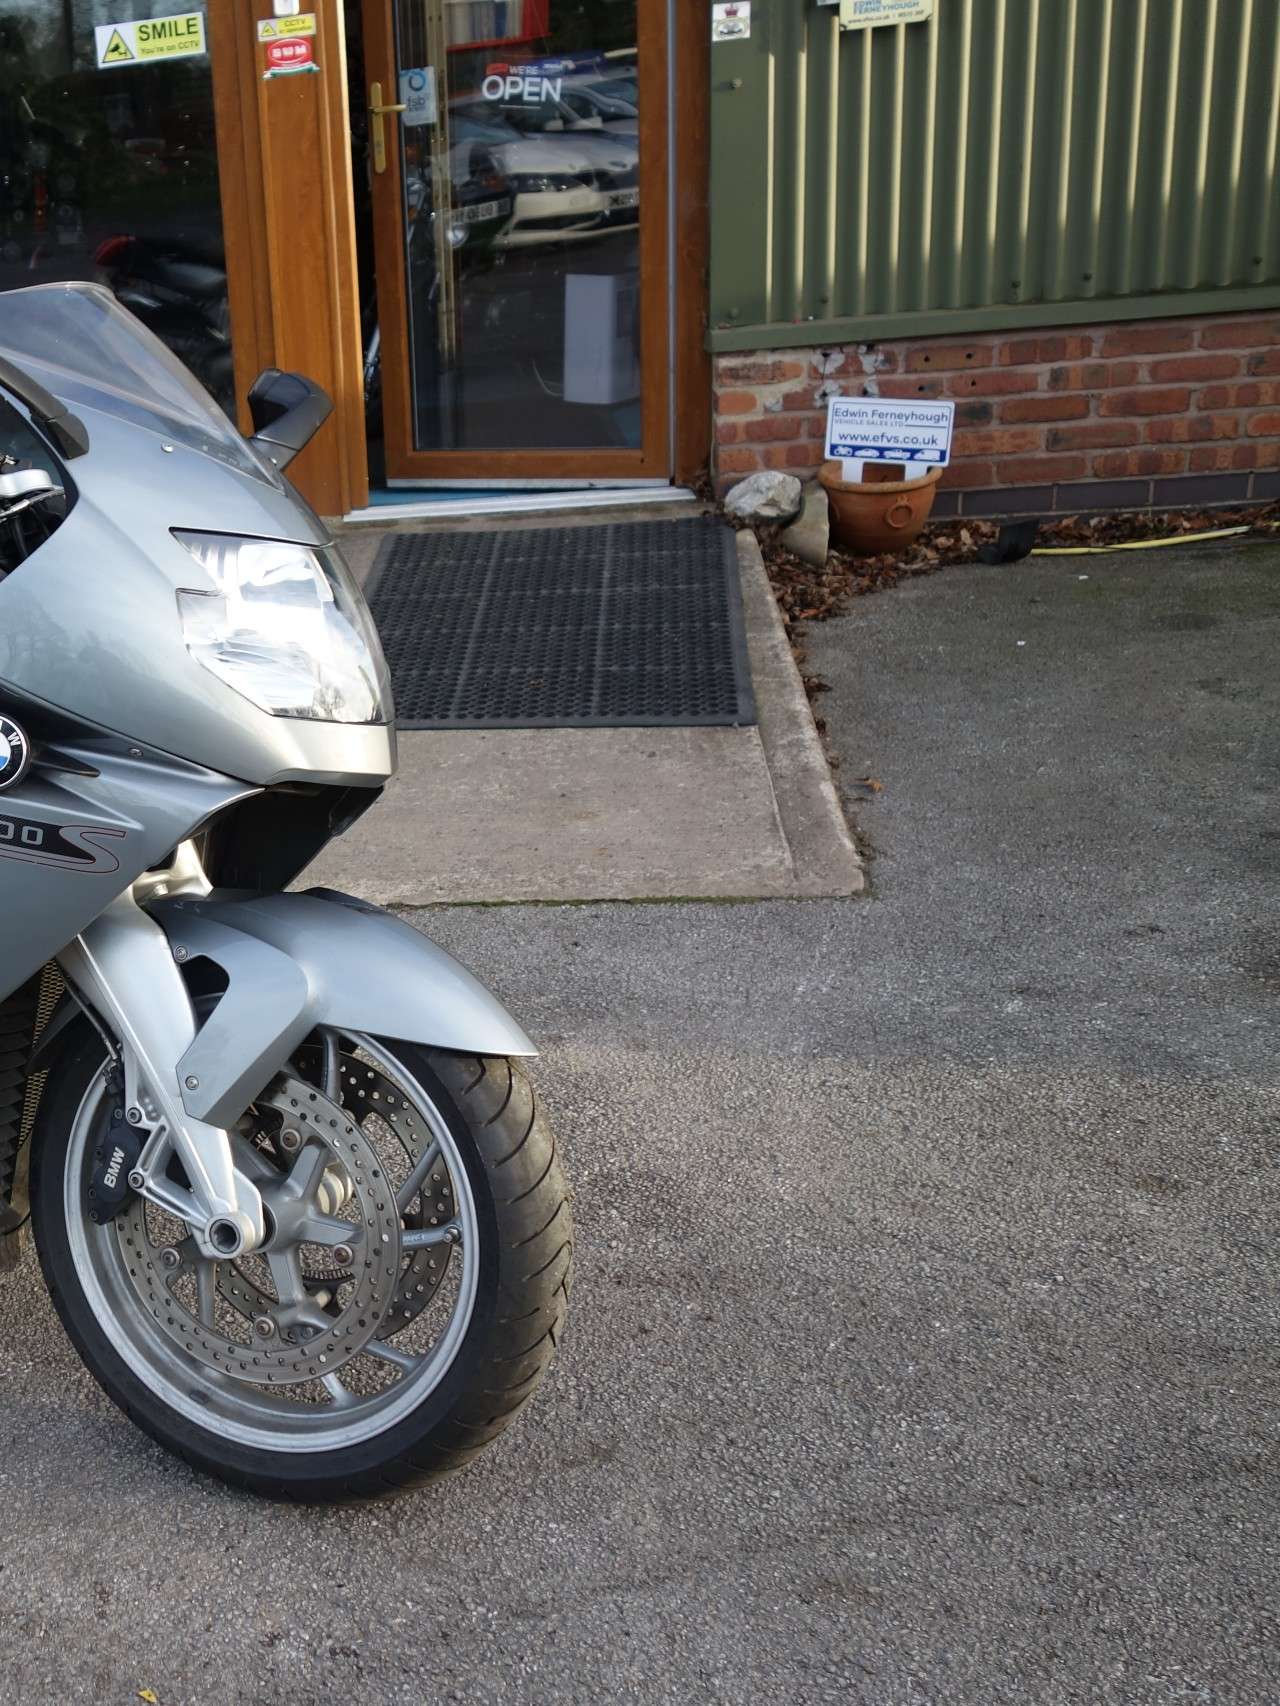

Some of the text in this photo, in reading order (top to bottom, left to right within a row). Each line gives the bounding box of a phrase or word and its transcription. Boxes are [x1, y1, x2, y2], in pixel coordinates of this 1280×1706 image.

[138, 17, 199, 41] SMILE
[178, 40, 199, 50] CCTV
[482, 75, 562, 102] OPEN
[834, 408, 948, 424] Edwin Ferneyhough
[838, 432, 938, 446] www.efvs.co.uk
[103, 1146, 125, 1189] BMW
